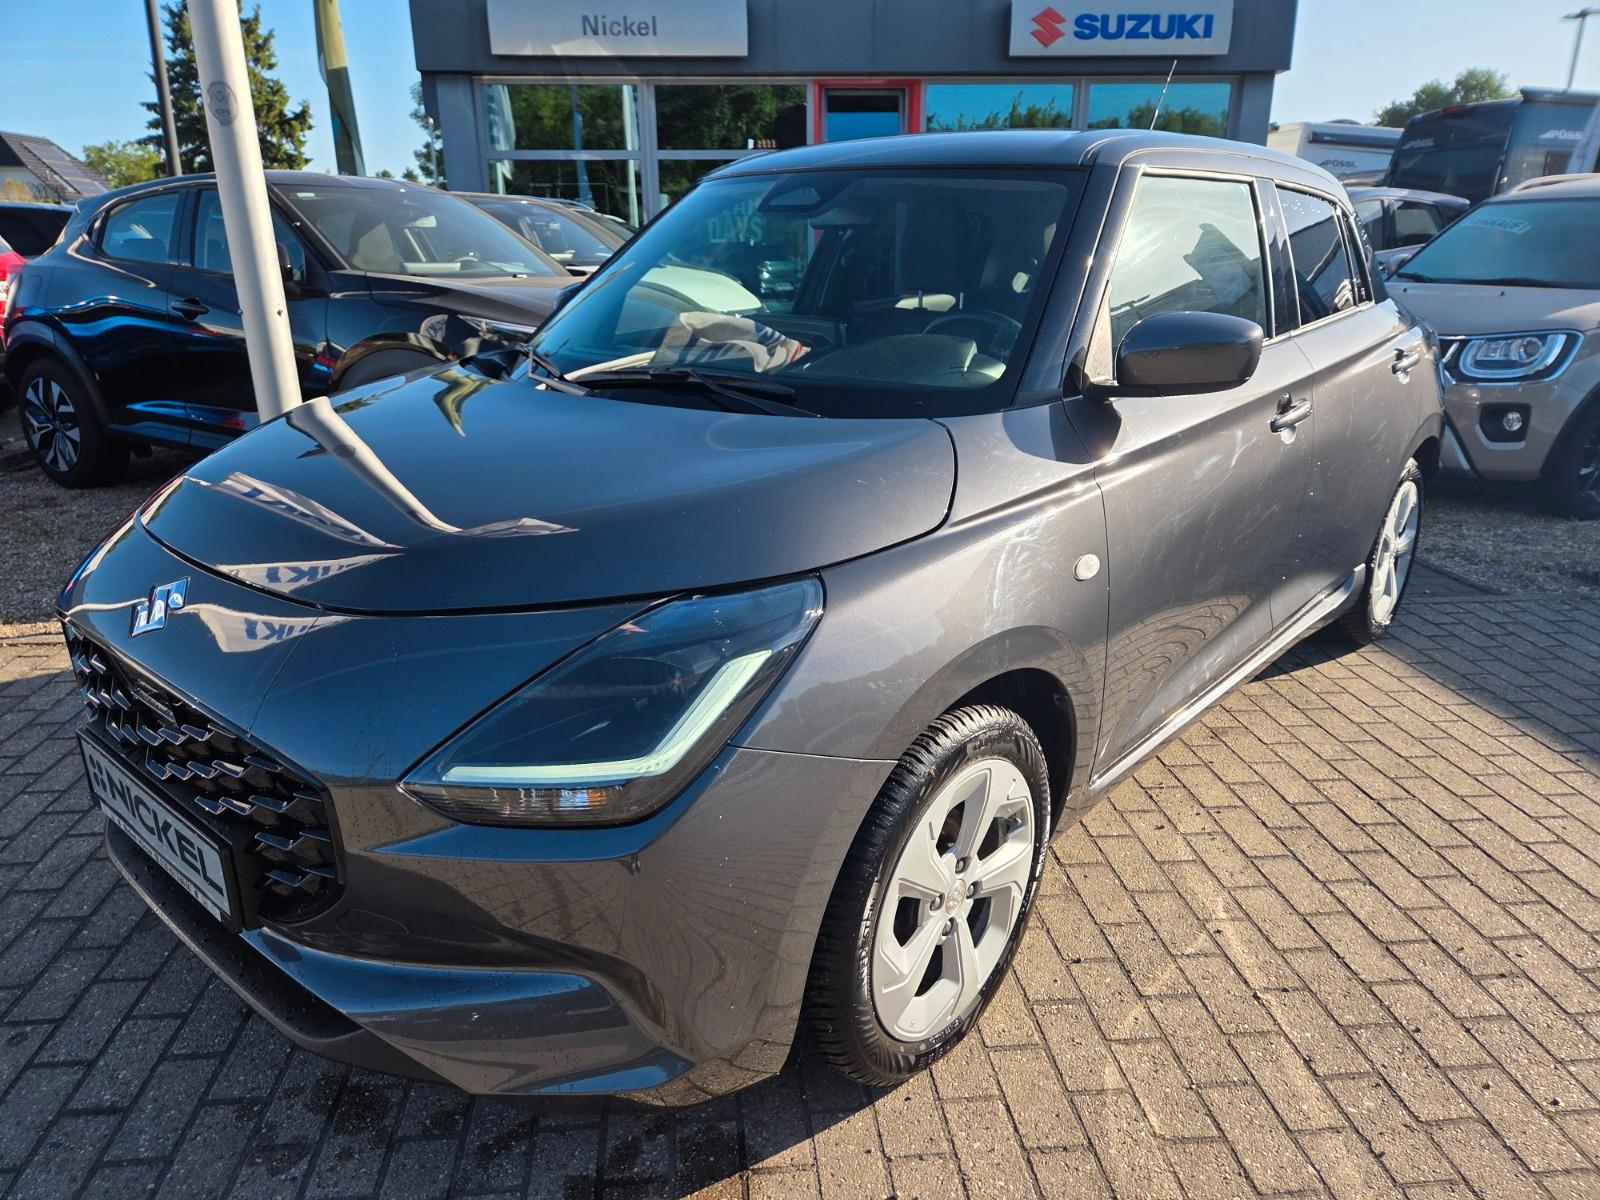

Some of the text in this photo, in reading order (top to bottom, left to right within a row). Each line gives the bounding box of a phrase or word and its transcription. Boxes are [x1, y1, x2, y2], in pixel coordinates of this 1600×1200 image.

[581, 14, 658, 36] Nickel
[1073, 13, 1214, 40] SUZUKI
[1551, 128, 1584, 140] PÖSS
[104, 767, 225, 897] NICKEL
